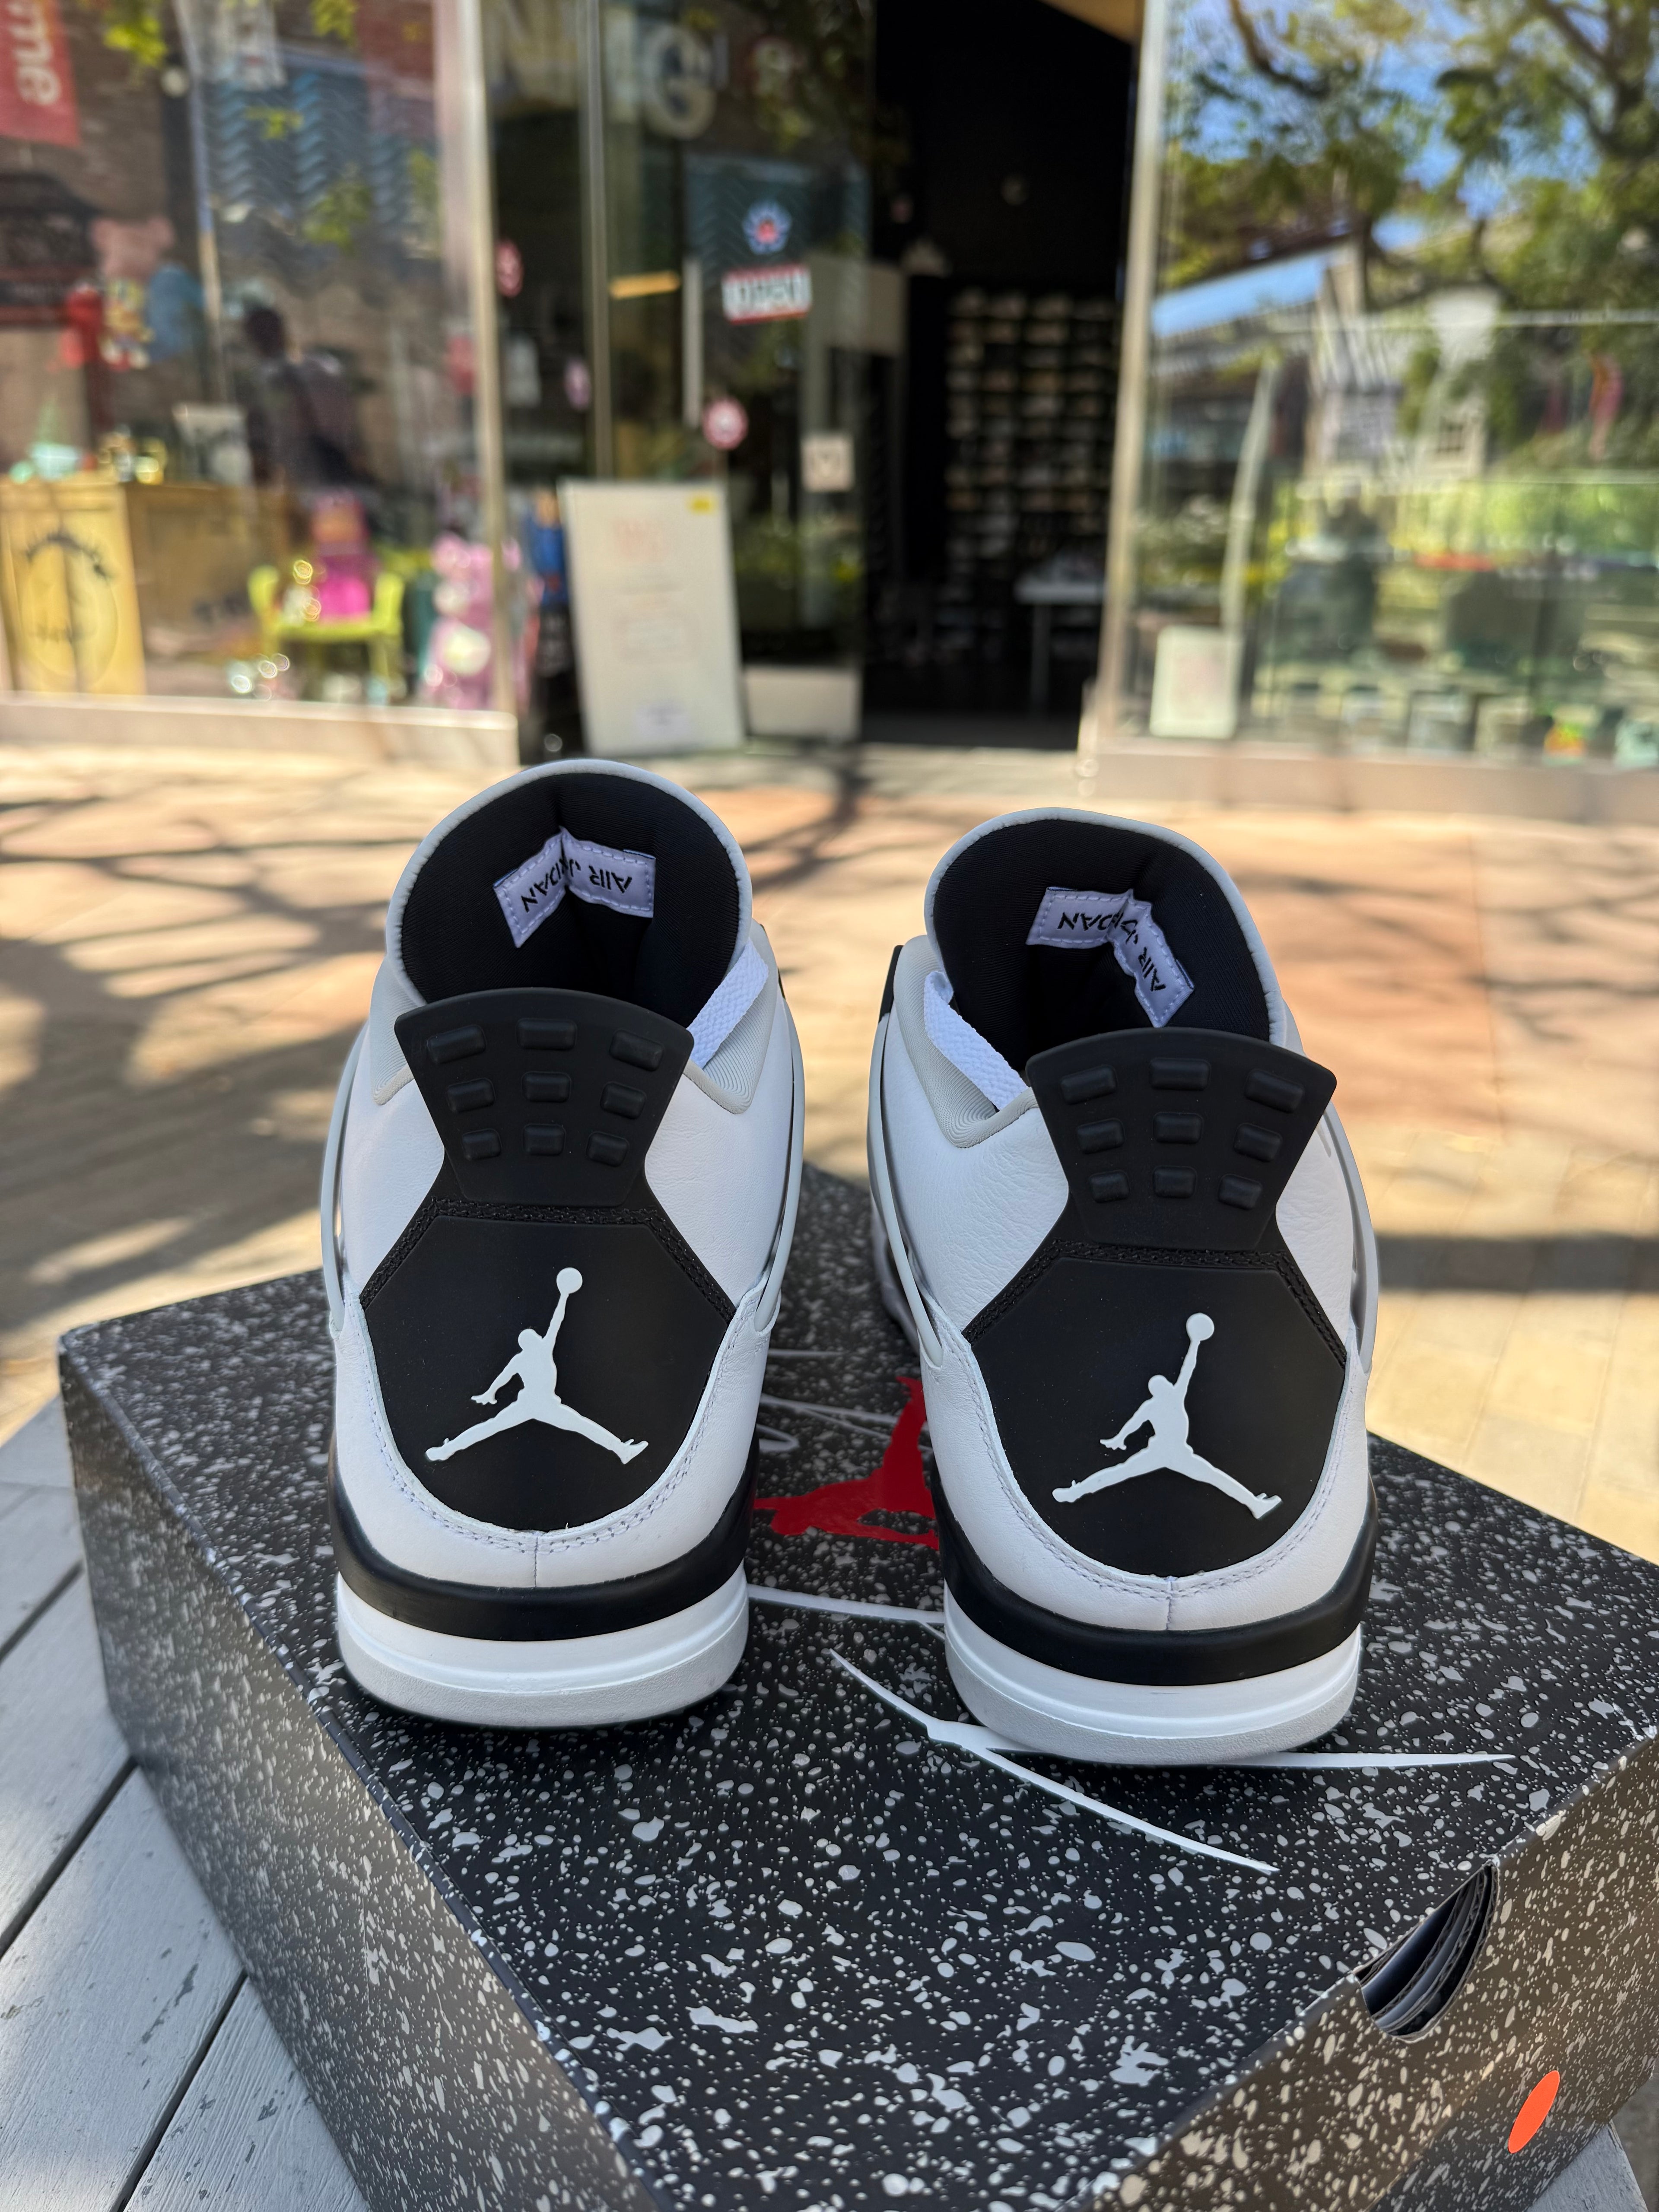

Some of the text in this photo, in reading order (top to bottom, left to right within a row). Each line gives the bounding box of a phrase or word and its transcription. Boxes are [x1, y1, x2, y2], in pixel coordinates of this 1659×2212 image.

[521, 858, 632, 912] AIR JDAN
[1138, 947, 1166, 992] AIR
